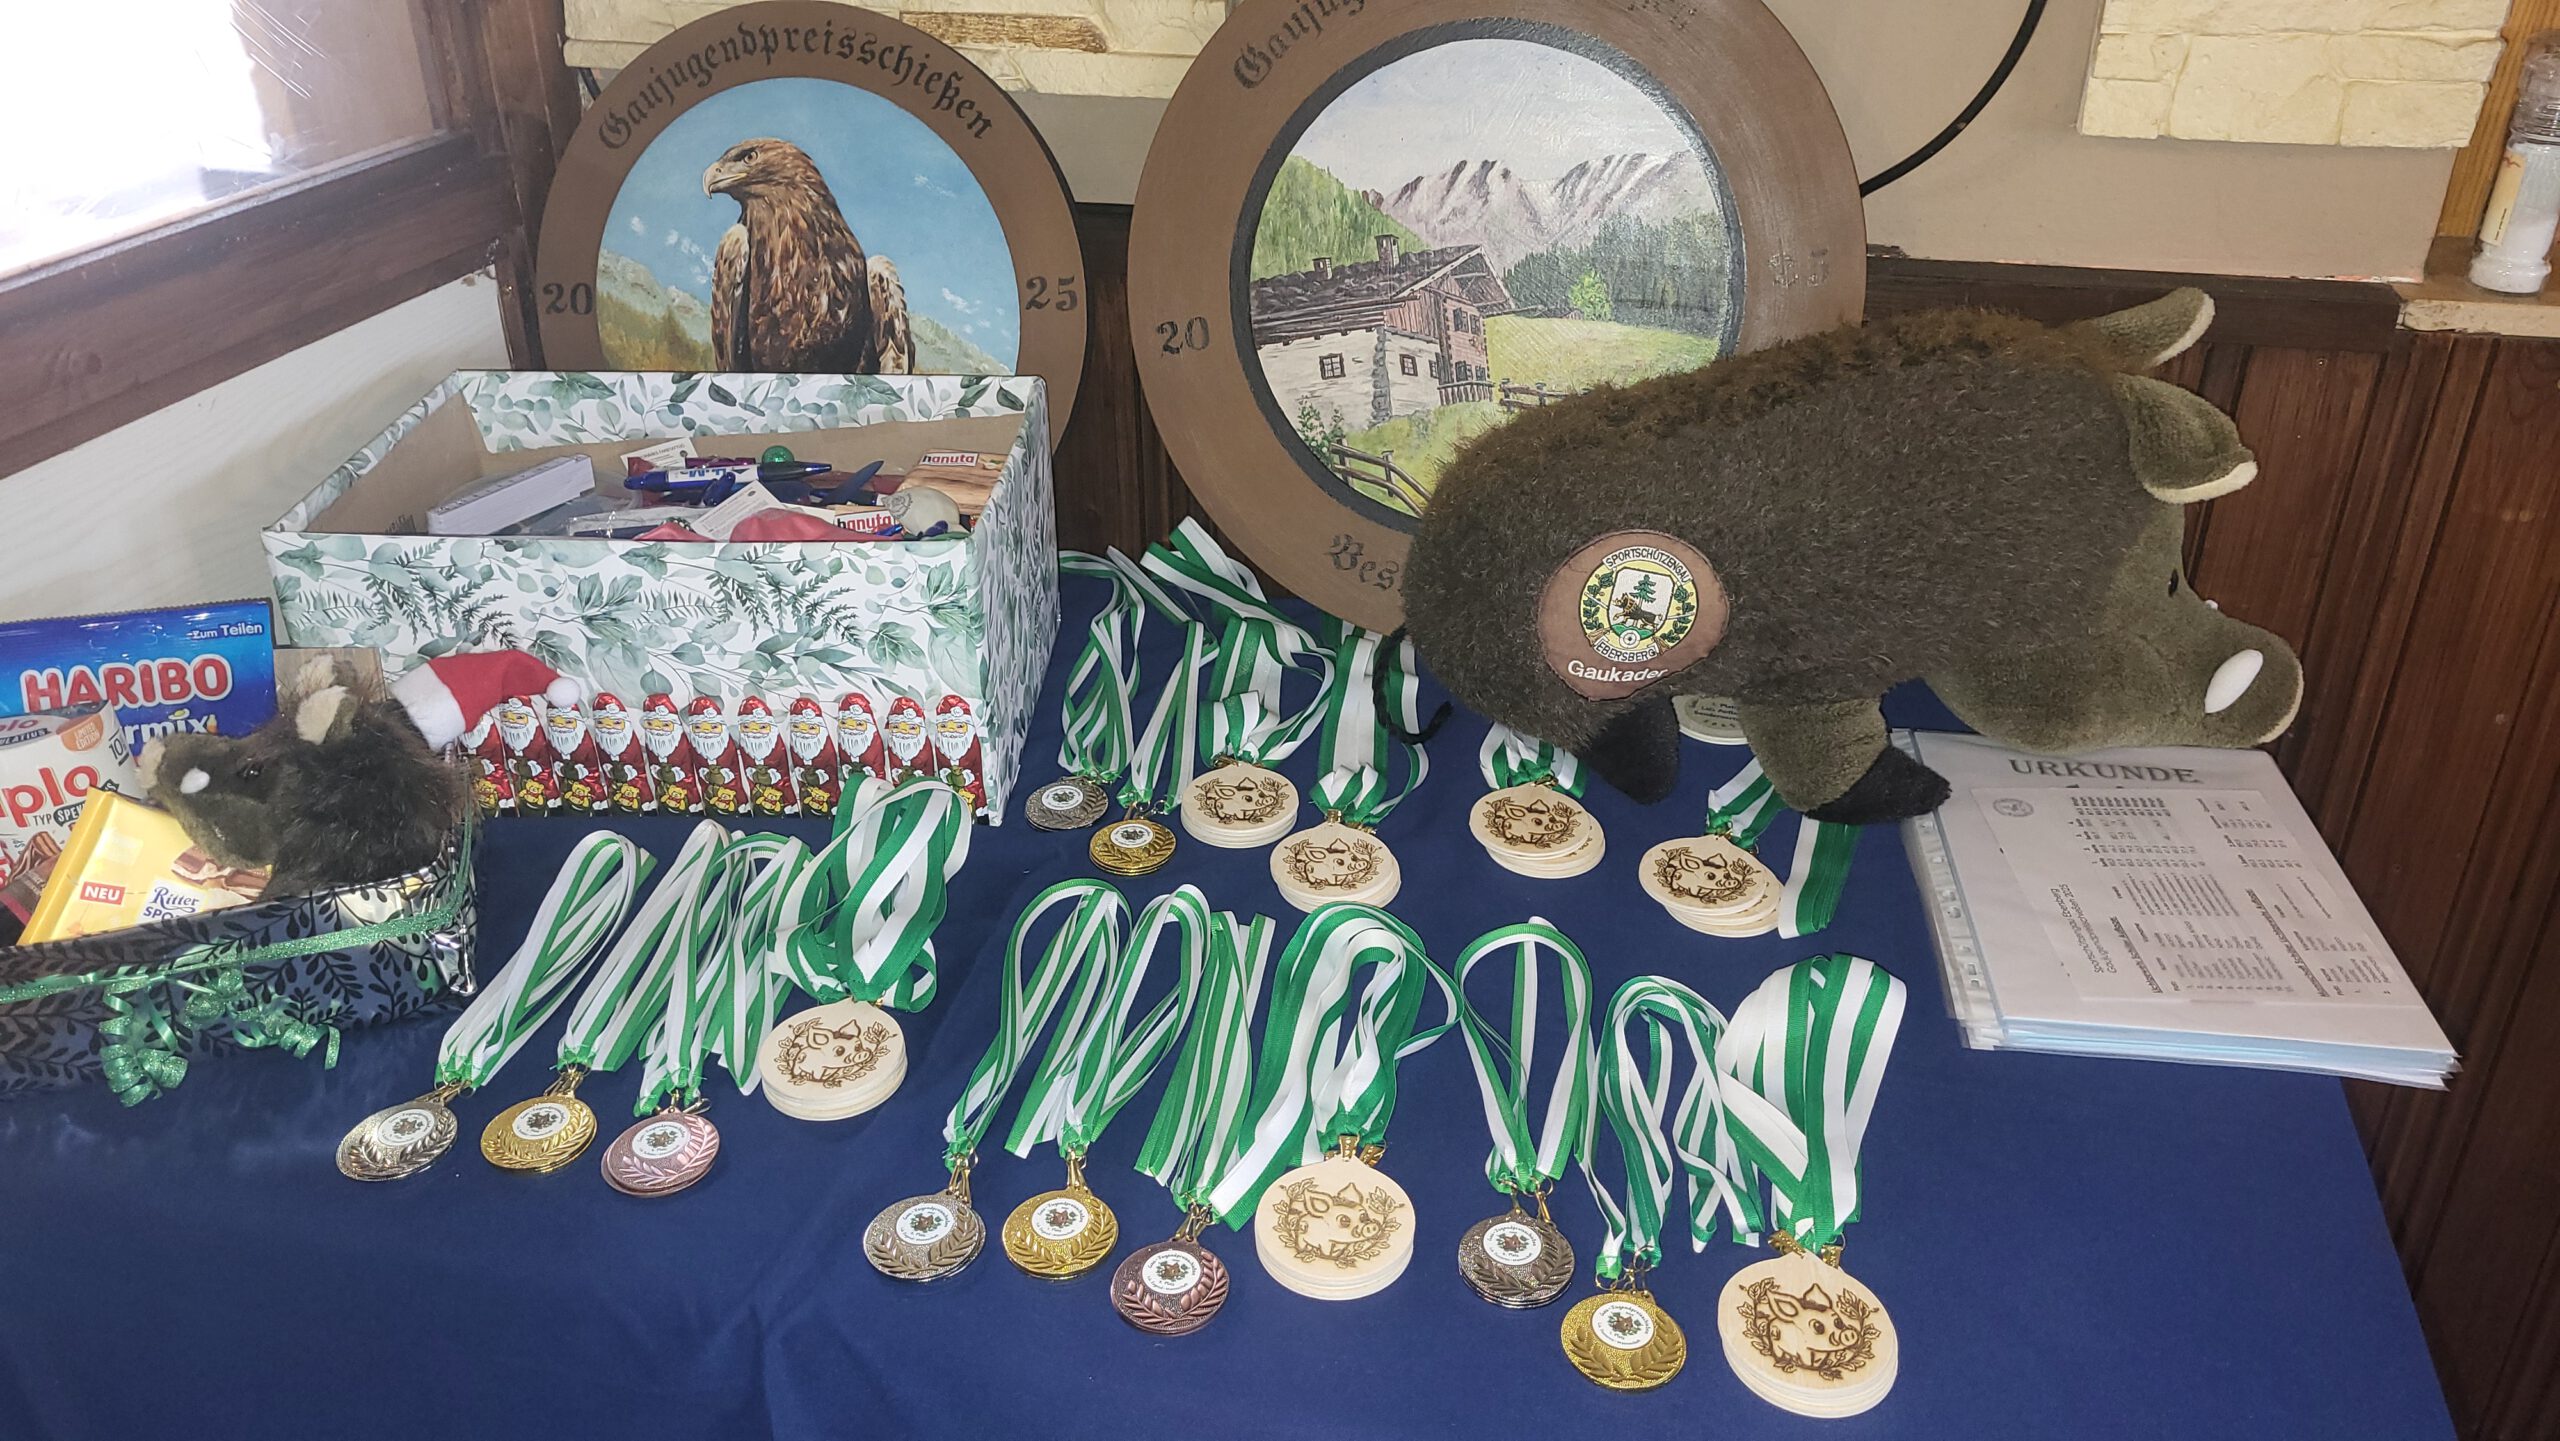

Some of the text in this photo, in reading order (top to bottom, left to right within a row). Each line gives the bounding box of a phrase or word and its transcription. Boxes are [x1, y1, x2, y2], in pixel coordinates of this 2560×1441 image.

[598, 19, 993, 150] Gaujugendpreisschießen
[542, 282, 596, 315] 20
[1025, 275, 1079, 311] 25
[1156, 316, 1209, 354] 20
[922, 454, 975, 464] hanuta
[1325, 534, 1403, 597] Bes
[192, 622, 263, 639] Zum Teilen
[1596, 642, 1656, 662] EBERSBERG
[22, 655, 232, 713] HARIBO
[1568, 660, 1669, 682] Gaukader
[121, 711, 208, 744] rmix
[2008, 759, 2204, 784] URKUNDE
[0, 765, 98, 829] plo
[33, 814, 52, 827] TYP
[84, 885, 120, 901] NEU
[150, 886, 199, 913] Ritter
[143, 905, 181, 920] SPO
